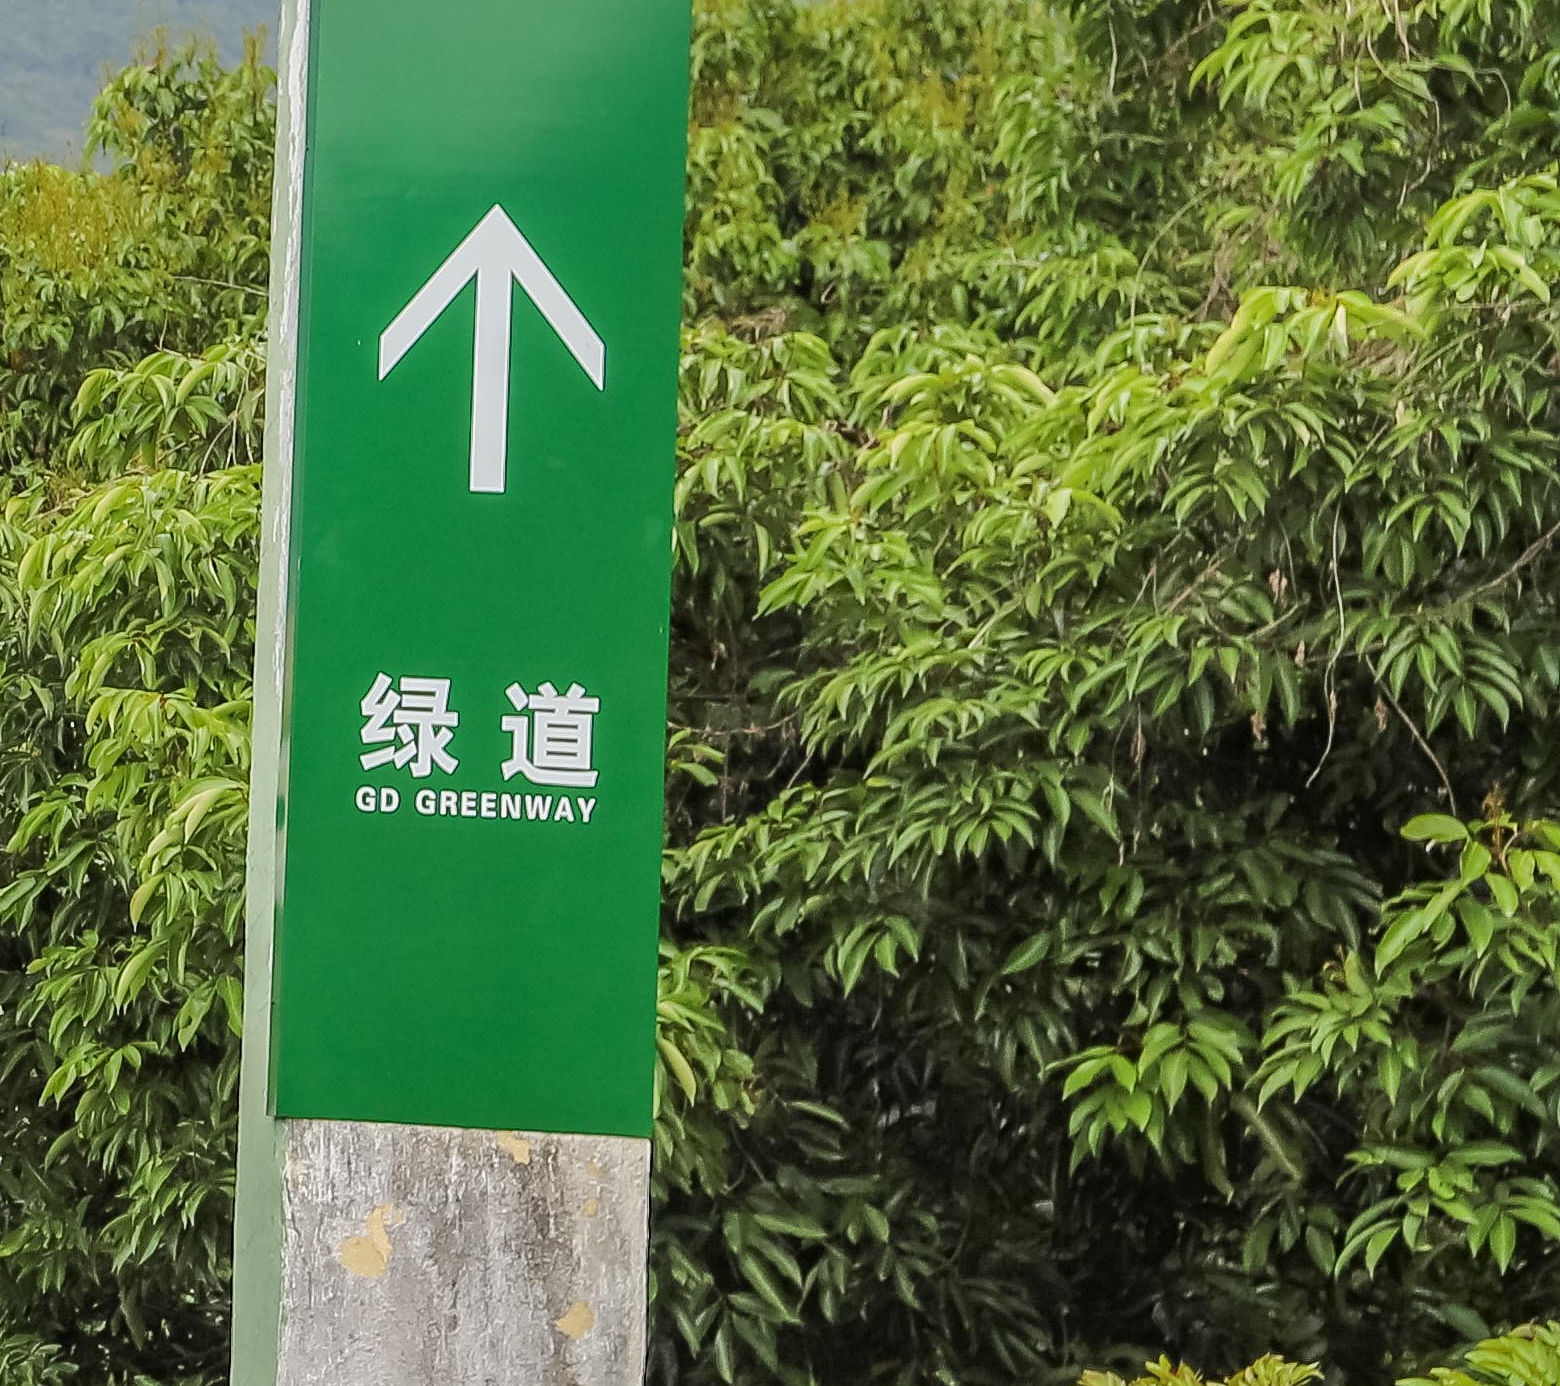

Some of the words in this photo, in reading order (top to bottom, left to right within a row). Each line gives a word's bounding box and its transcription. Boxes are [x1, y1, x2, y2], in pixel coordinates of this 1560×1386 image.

[359, 671, 601, 788] 绿道
[355, 786, 400, 813] GD
[415, 789, 597, 823] GREENWAY
